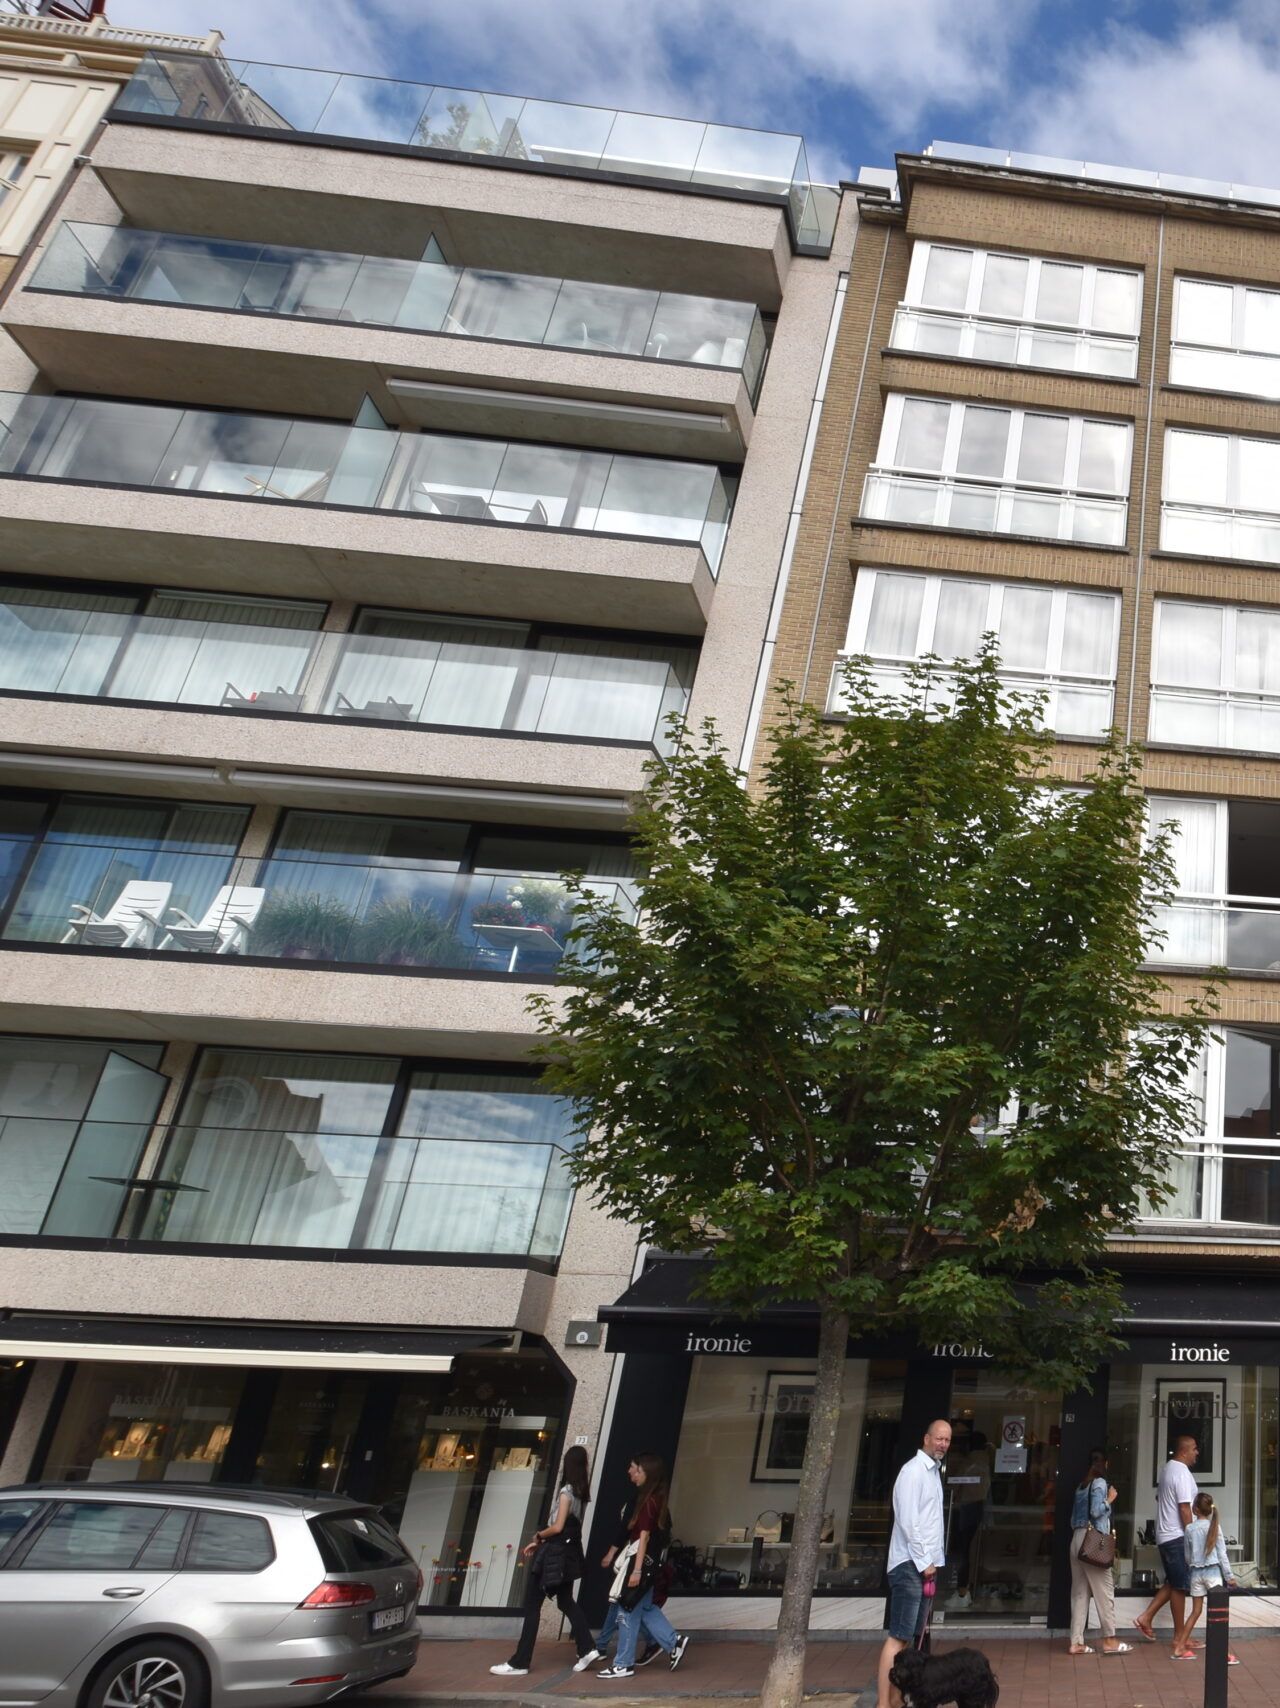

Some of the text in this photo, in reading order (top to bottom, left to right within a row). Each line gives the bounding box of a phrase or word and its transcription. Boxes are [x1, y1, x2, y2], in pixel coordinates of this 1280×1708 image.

[684, 1332, 752, 1353] ironie
[1170, 1342, 1230, 1362] ironie
[442, 1406, 516, 1418] BASKANIA
[1149, 1394, 1239, 1420] ironie
